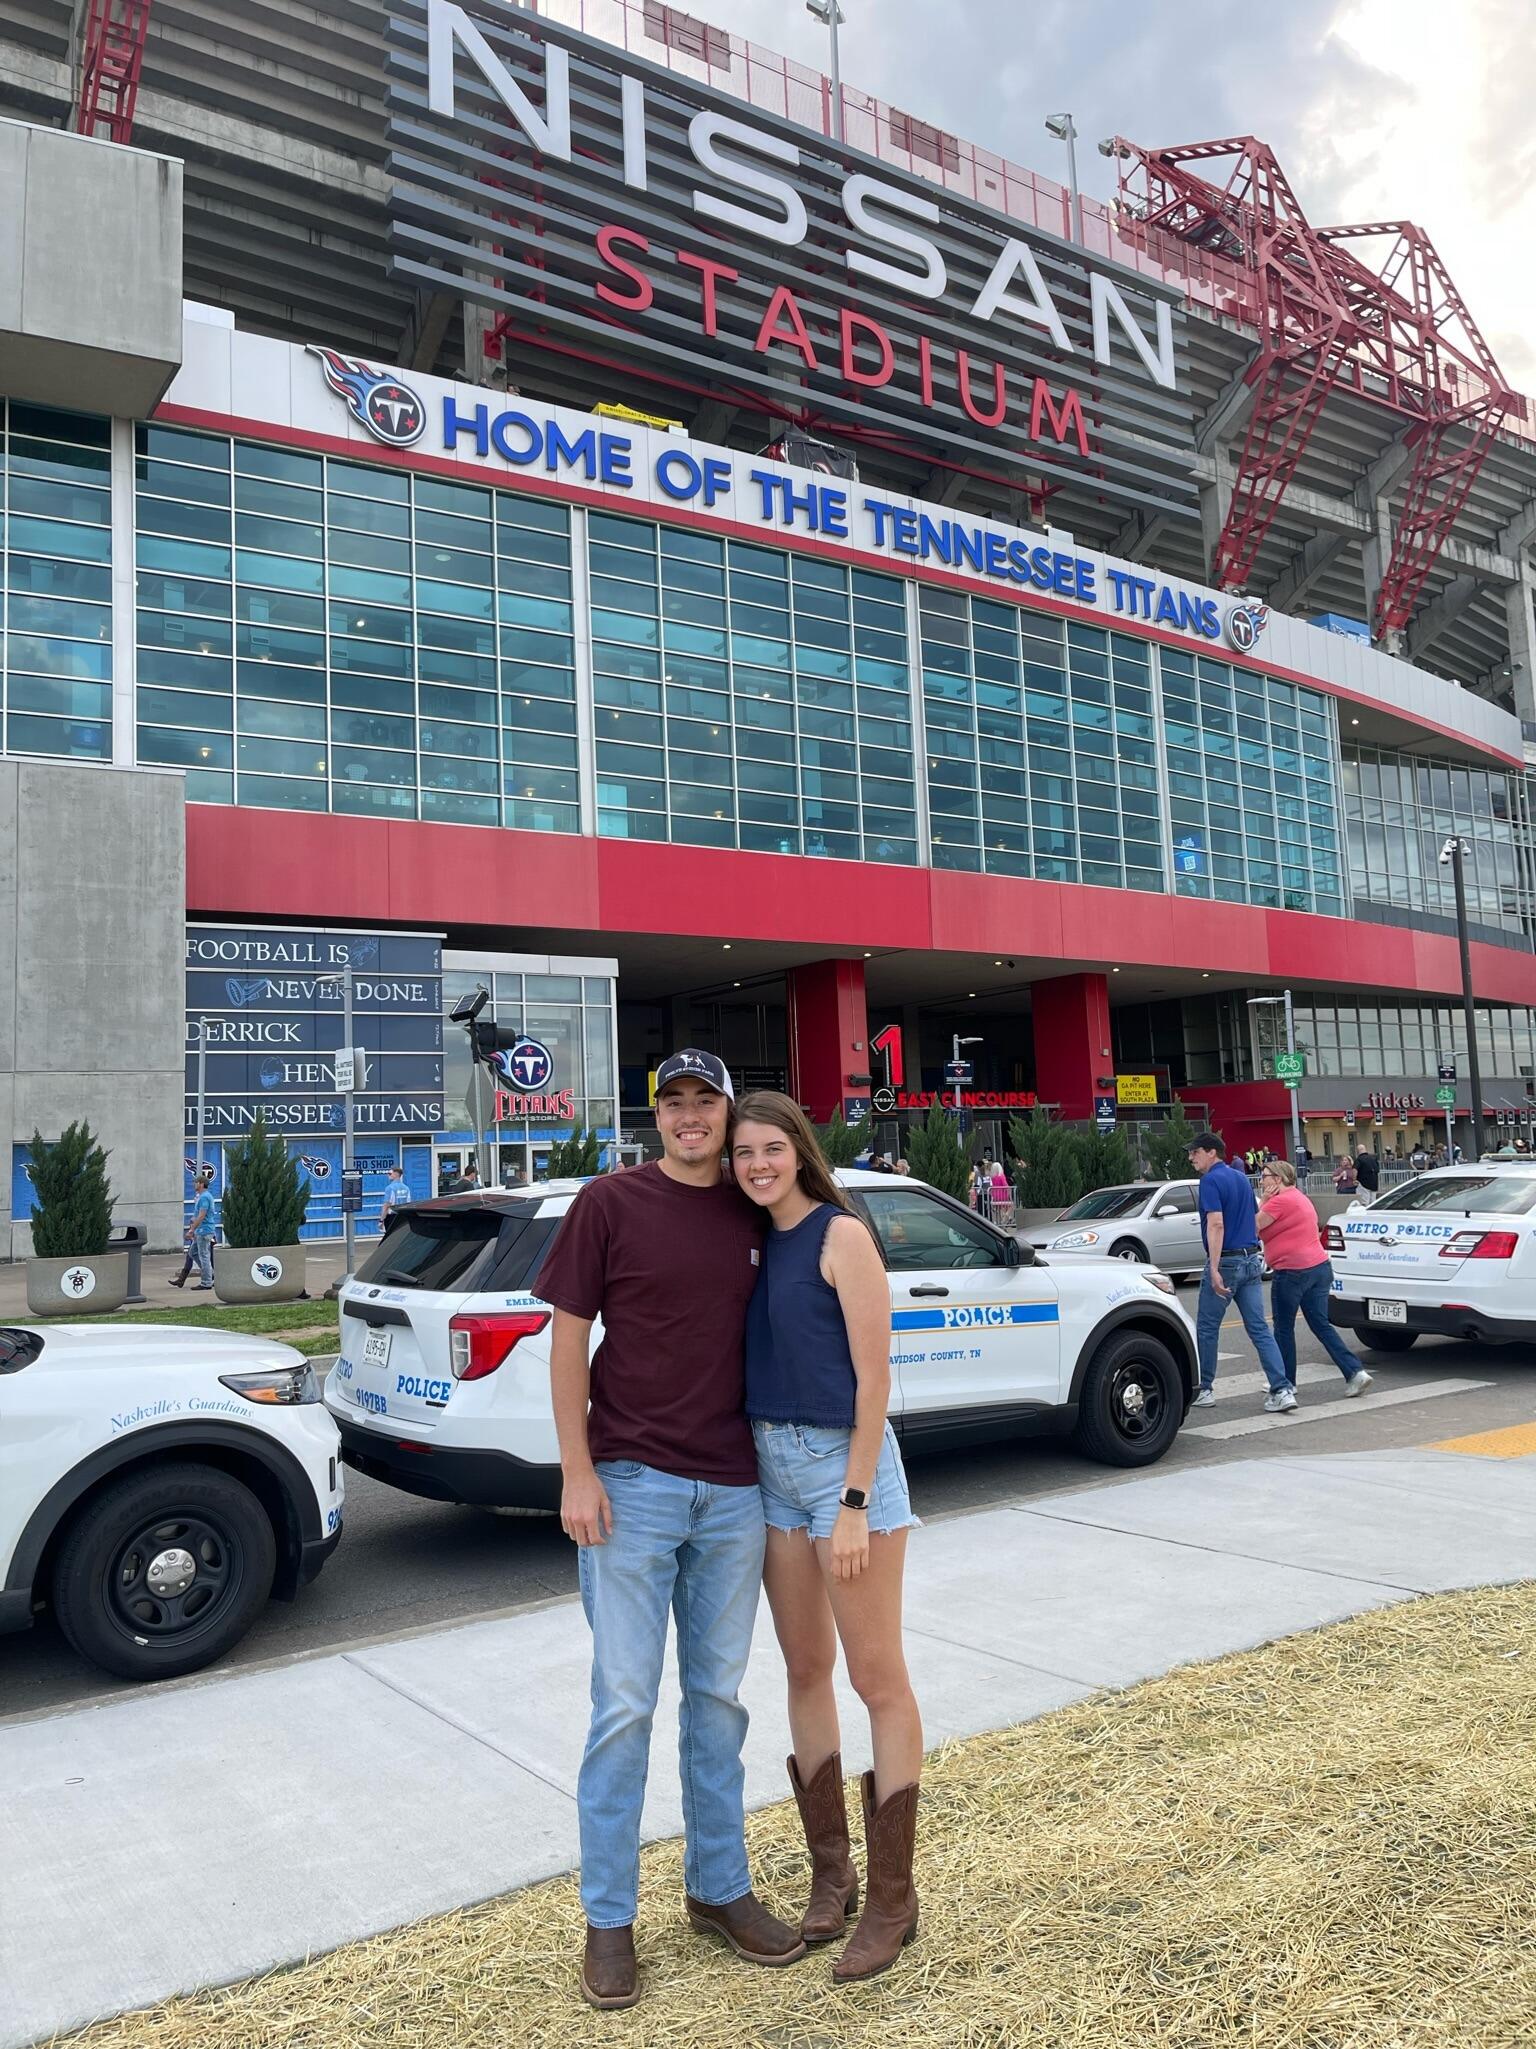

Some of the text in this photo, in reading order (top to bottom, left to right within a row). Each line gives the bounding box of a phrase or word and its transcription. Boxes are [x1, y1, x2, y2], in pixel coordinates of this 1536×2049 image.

[427, 0, 1176, 390] NISSAN
[596, 226, 1090, 457] STADIUM
[443, 396, 1221, 639] HOME OF THE TENNESSEE TITANS
[185, 939, 350, 964] FOOTBALL IS
[265, 980, 428, 1002] NEVER DONE.
[185, 1022, 301, 1042] DERRICK
[869, 1024, 904, 1087] 1
[283, 1063, 373, 1083] HENY
[491, 1089, 574, 1122] TITANS
[897, 1091, 937, 1108] EAST
[1369, 1091, 1425, 1109] tickets
[353, 1102, 442, 1124] TITANS
[371, 1160, 394, 1169] SHOP
[1345, 1223, 1453, 1237] METRO POLICE
[505, 1298, 544, 1306] EMERG
[1372, 1305, 1402, 1317] 1197-GF
[942, 1305, 1013, 1328] POLICE
[889, 1349, 981, 1365] AVIDSON COUNTY, TN
[396, 1375, 452, 1401] POLICE
[355, 1388, 388, 1413] 9197BB
[110, 1397, 254, 1434] Nashville's Guardians
